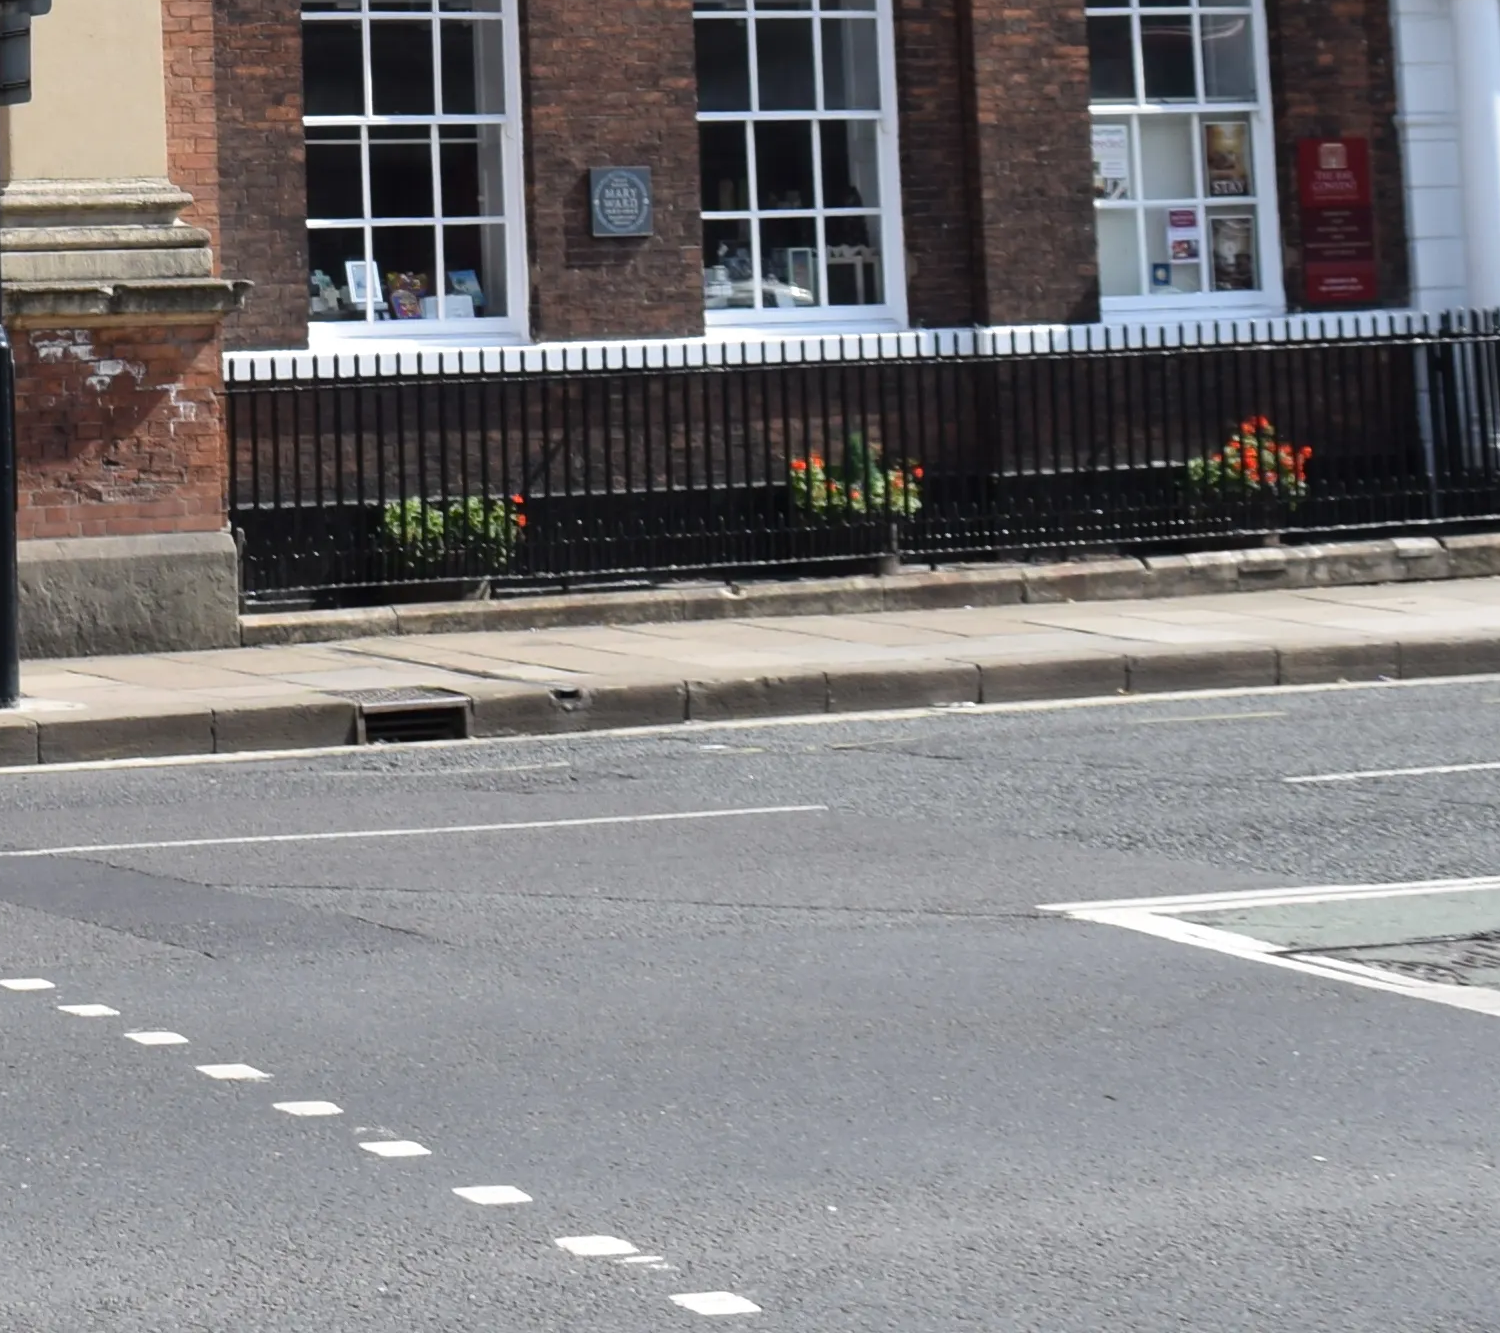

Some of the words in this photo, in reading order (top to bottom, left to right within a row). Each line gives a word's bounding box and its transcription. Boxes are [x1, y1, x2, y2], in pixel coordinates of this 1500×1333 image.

[604, 187, 637, 199] MARY
[1211, 180, 1245, 195] STAY
[602, 198, 638, 209] WARD
